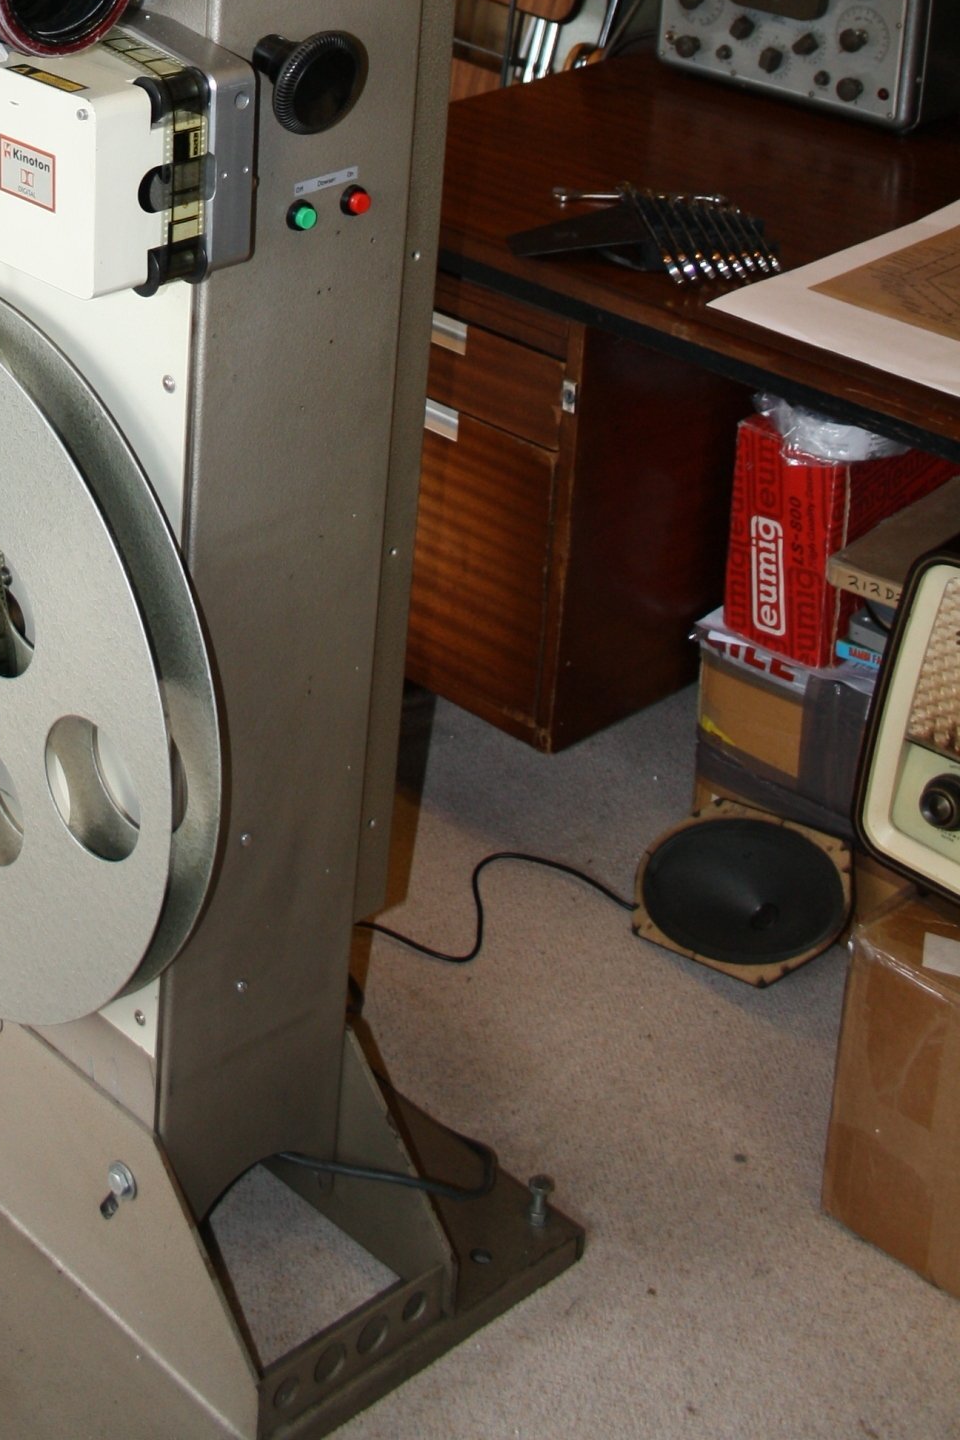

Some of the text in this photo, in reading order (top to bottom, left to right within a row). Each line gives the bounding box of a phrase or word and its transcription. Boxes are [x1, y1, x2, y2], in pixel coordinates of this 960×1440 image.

[12, 147, 51, 173] Kinoton
[17, 185, 36, 199] DIGITAL
[788, 495, 805, 567] LS-800
[753, 516, 784, 630] eumig
